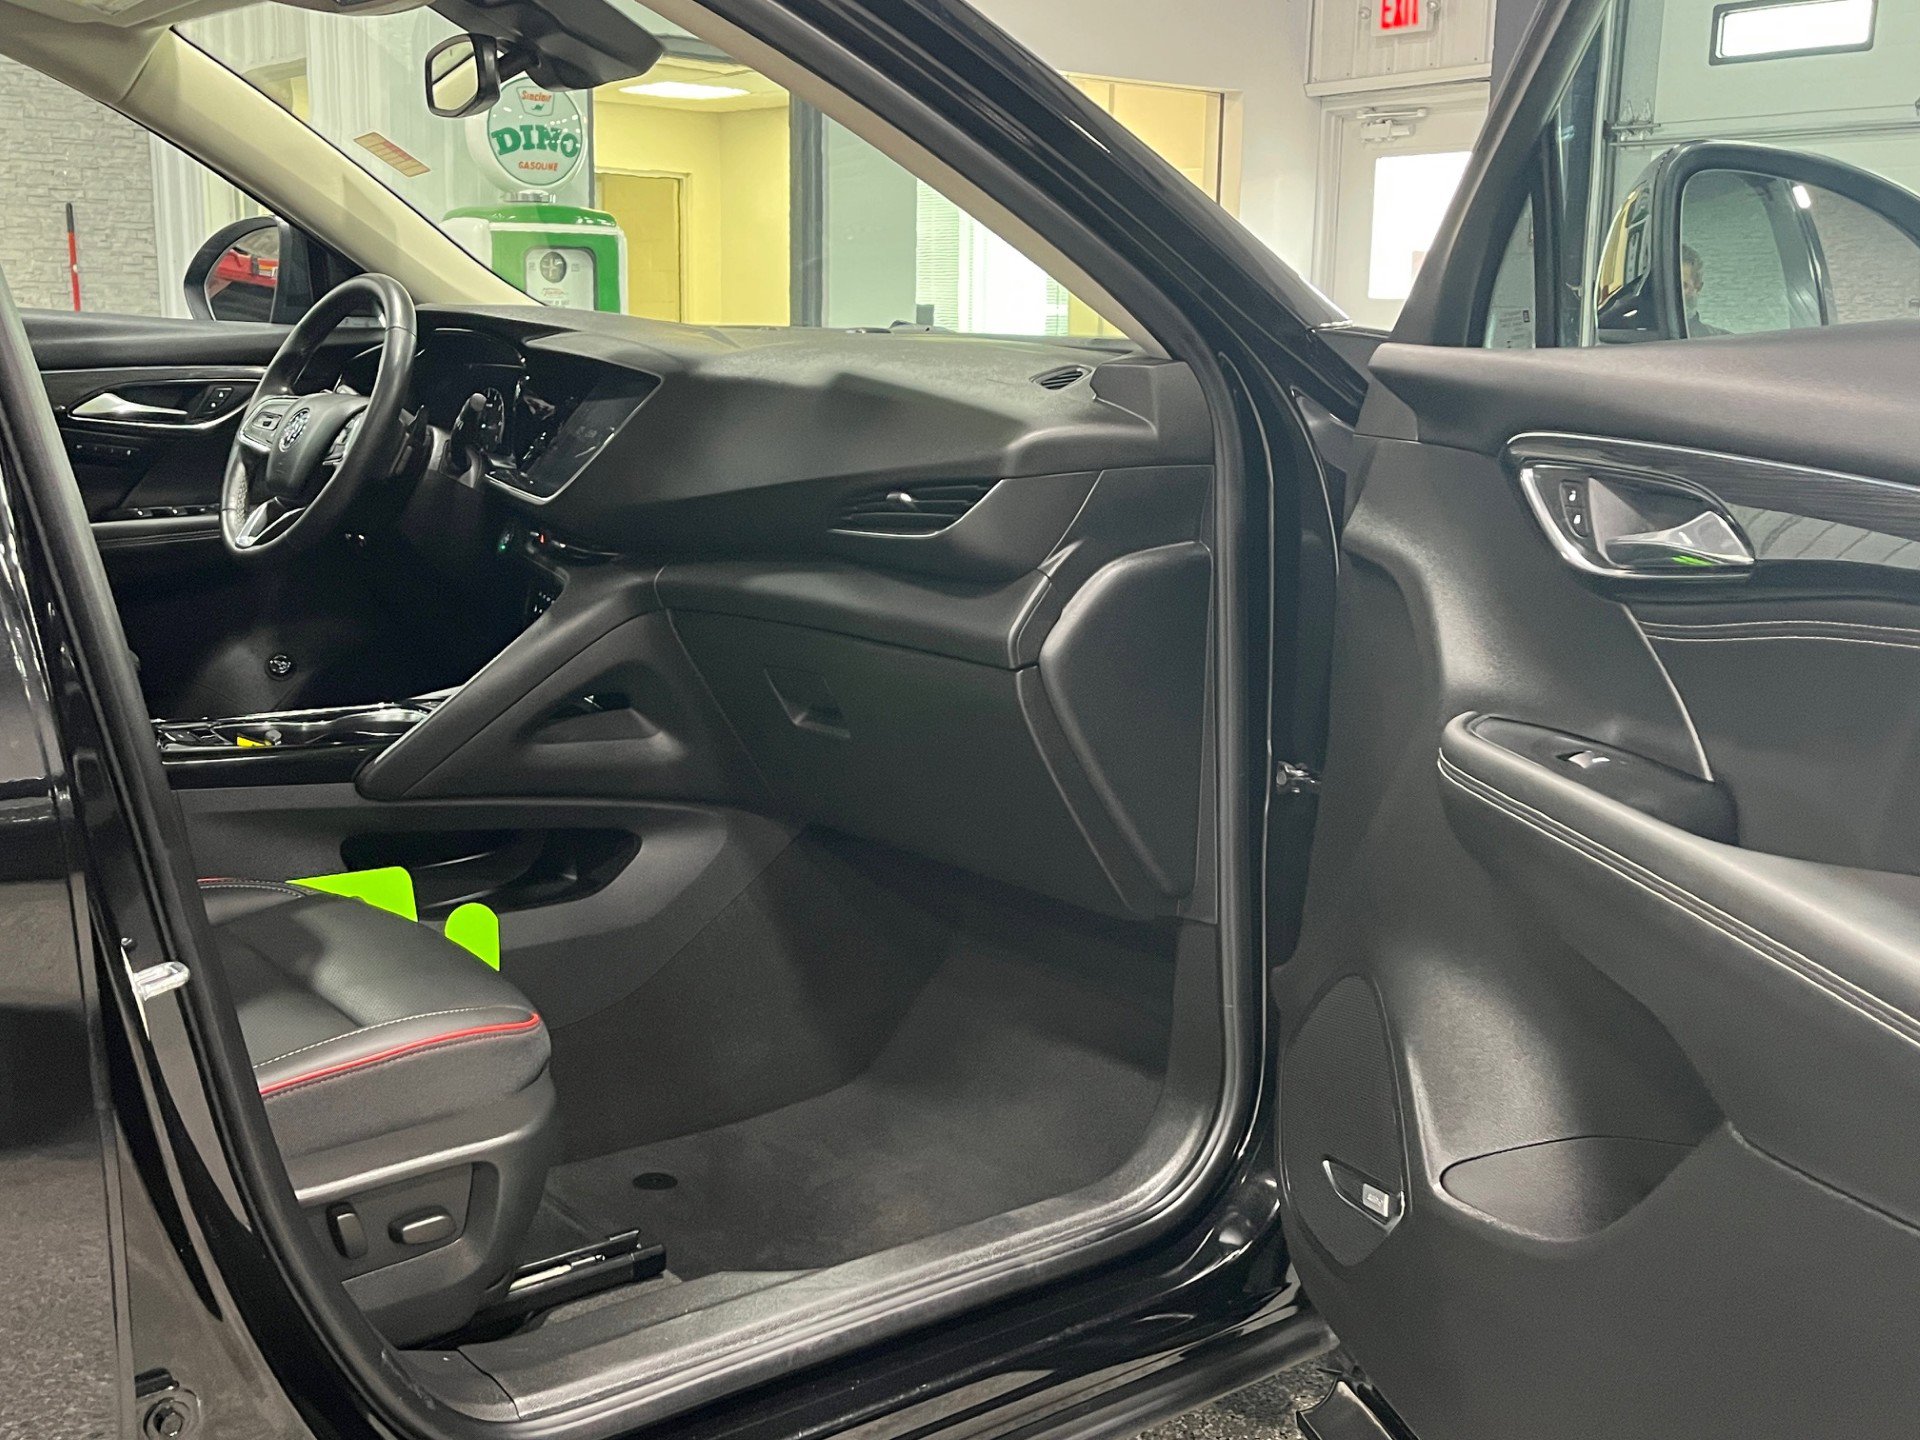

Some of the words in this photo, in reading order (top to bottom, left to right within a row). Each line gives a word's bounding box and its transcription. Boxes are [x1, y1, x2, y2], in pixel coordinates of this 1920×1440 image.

[1381, 0, 1418, 29] EXIT
[521, 90, 552, 102] Sinclair
[491, 124, 580, 158] DINO
[518, 161, 559, 171] GASOLINE
